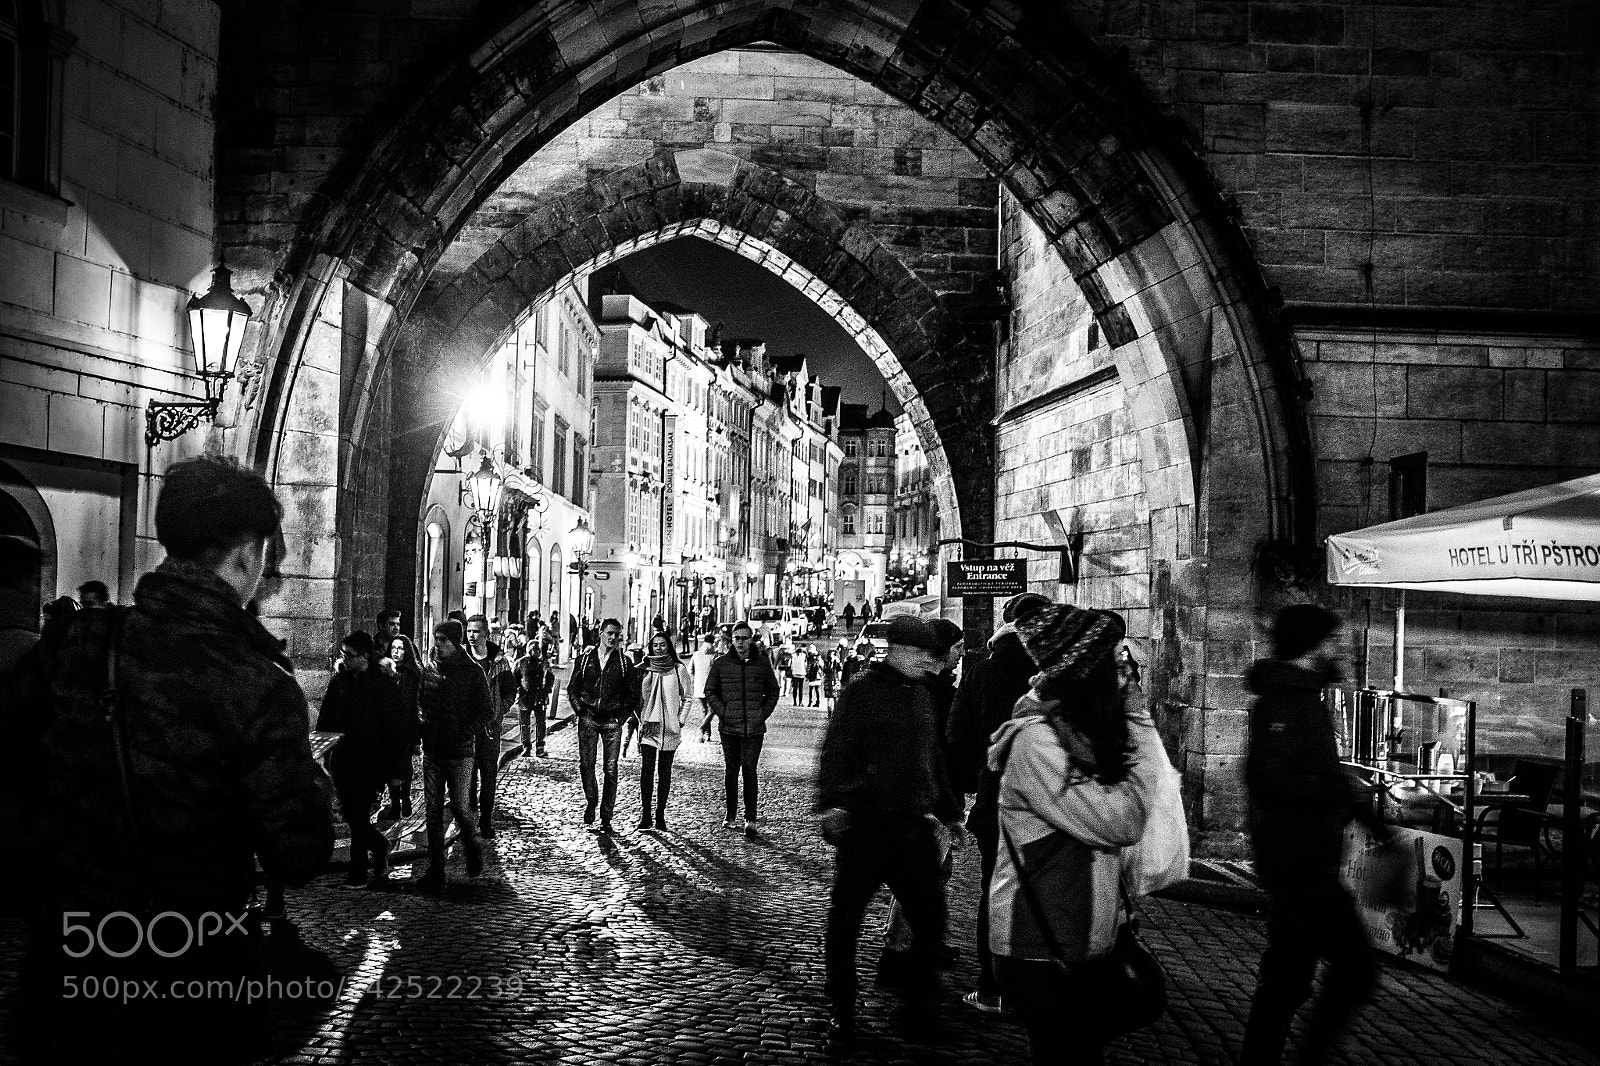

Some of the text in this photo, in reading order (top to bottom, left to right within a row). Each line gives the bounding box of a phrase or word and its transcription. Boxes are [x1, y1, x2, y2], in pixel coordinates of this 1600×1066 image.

[1449, 539, 1600, 567] HOTEL U TŘÍ PŠTRO
[960, 564, 985, 574] Vstup
[1000, 562, 1015, 572] věž
